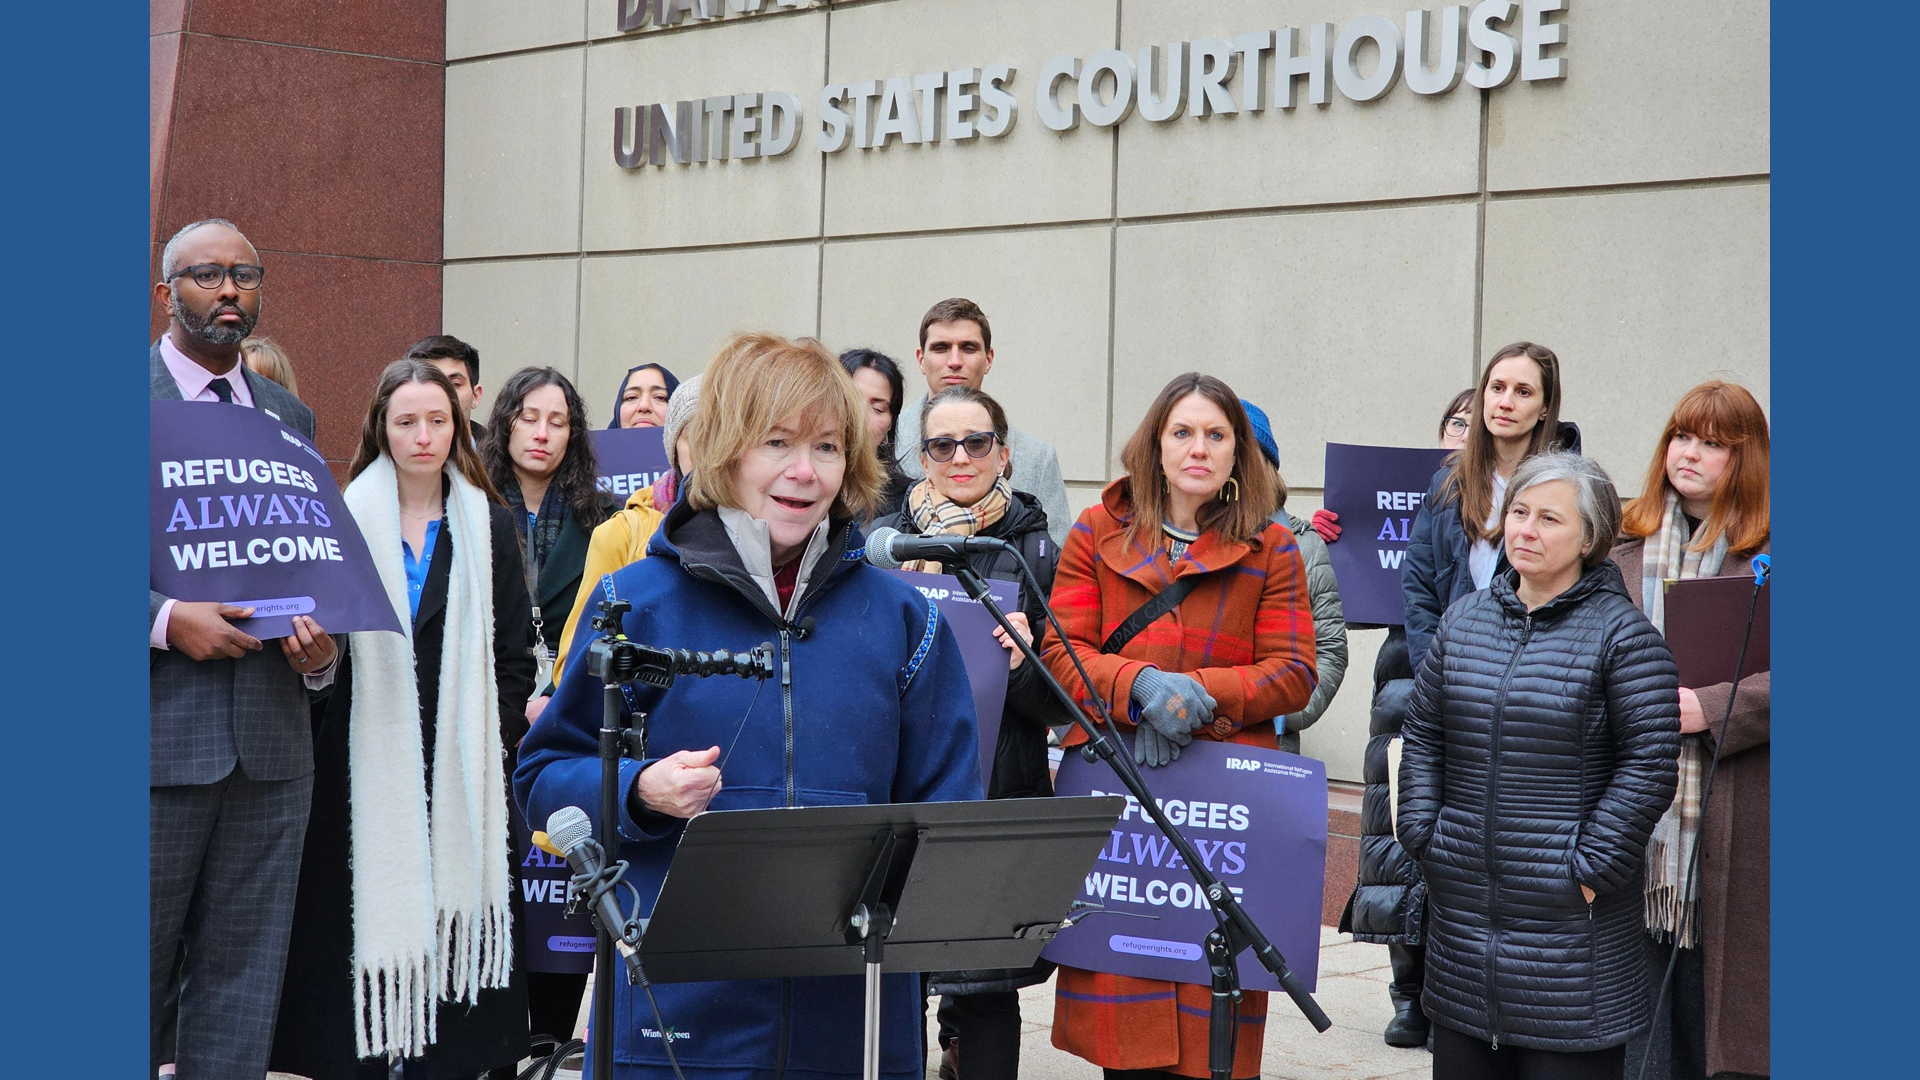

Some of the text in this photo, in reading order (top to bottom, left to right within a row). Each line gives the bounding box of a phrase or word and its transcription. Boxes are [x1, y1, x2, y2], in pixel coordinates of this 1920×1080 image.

[613, 0, 1569, 169] UNITED STATES COURTHOUSE
[161, 459, 318, 492] REFUGEES
[596, 471, 670, 495] REFU
[1376, 491, 1426, 511] REF
[166, 493, 331, 532] ALWAYS
[1377, 517, 1410, 541] AL
[169, 536, 343, 571] WELCOME
[915, 586, 949, 600] RAP
[256, 603, 300, 613] erights.org
[1226, 757, 1261, 771] IRAP
[1264, 762, 1313, 775] International Refugee
[1264, 767, 1306, 779] Assistance Project
[1091, 790, 1250, 831] FUGEES
[1122, 941, 1187, 956] refugeerights.org
[641, 1028, 690, 1043] Wintegreen
